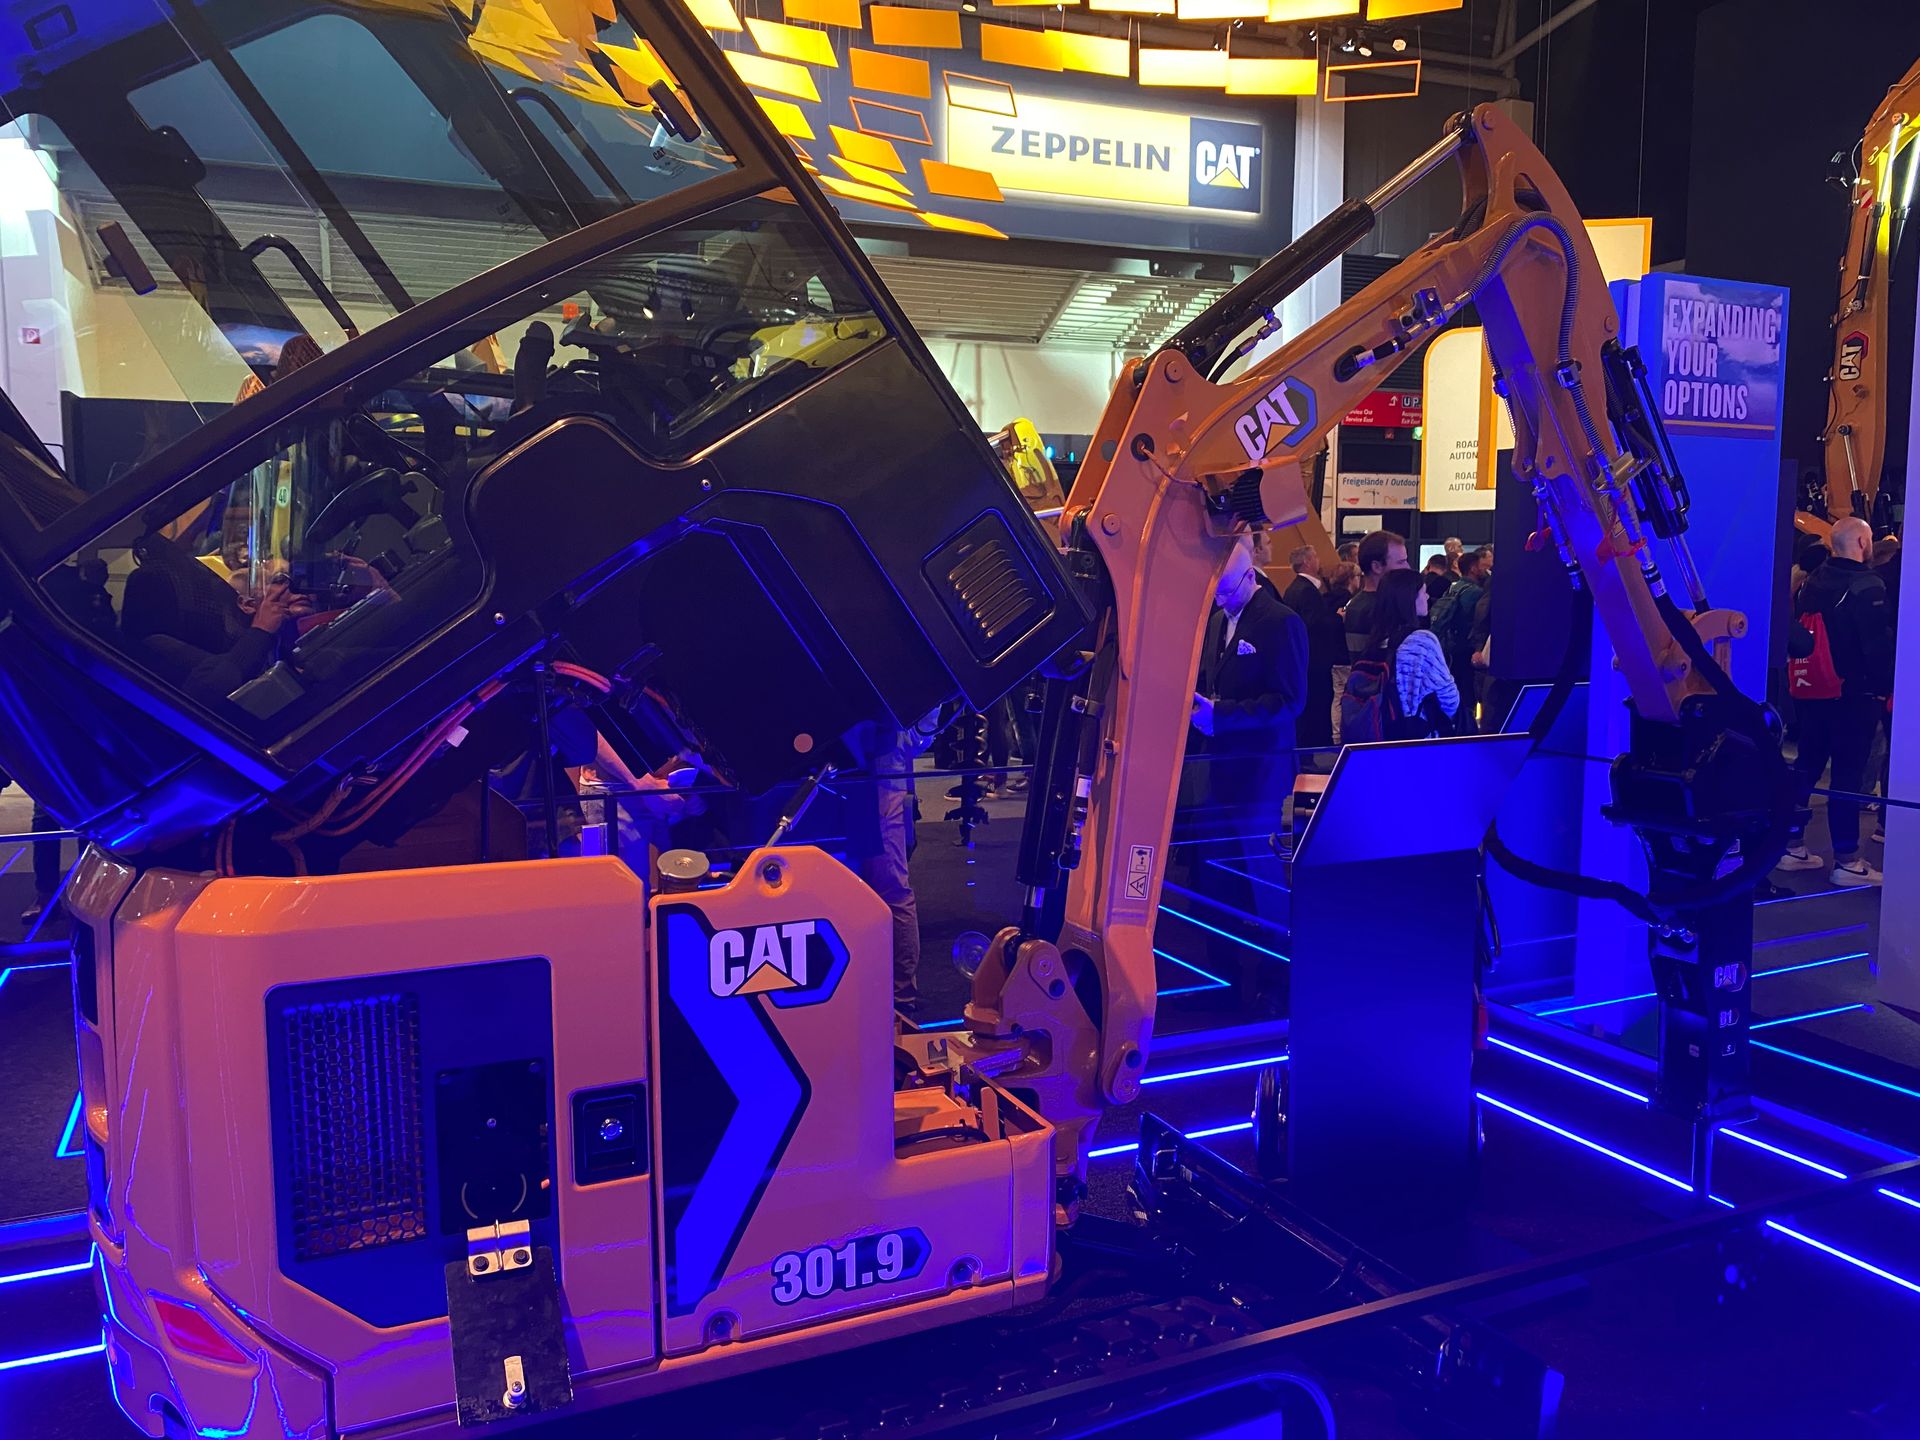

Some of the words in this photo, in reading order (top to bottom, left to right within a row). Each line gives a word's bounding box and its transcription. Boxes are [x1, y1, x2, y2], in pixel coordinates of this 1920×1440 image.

[991, 125, 1170, 172] ZEPPELIN
[1195, 141, 1256, 189] CAT
[1667, 298, 1777, 344] EXPANDING
[1666, 338, 1718, 378] YOUR
[1840, 344, 1862, 380] CAT
[1345, 415, 1363, 423] Service
[1664, 379, 1748, 420] OPTIONS
[1235, 381, 1300, 460] CAT
[1455, 440, 1478, 448] ROAD
[1342, 477, 1383, 487] Freigelände
[1390, 478, 1420, 487] Outdoor
[709, 920, 815, 997] CAT
[1714, 963, 1739, 988] CAT
[1720, 1009, 1732, 1026] B1
[773, 1233, 904, 1303] 301.9
